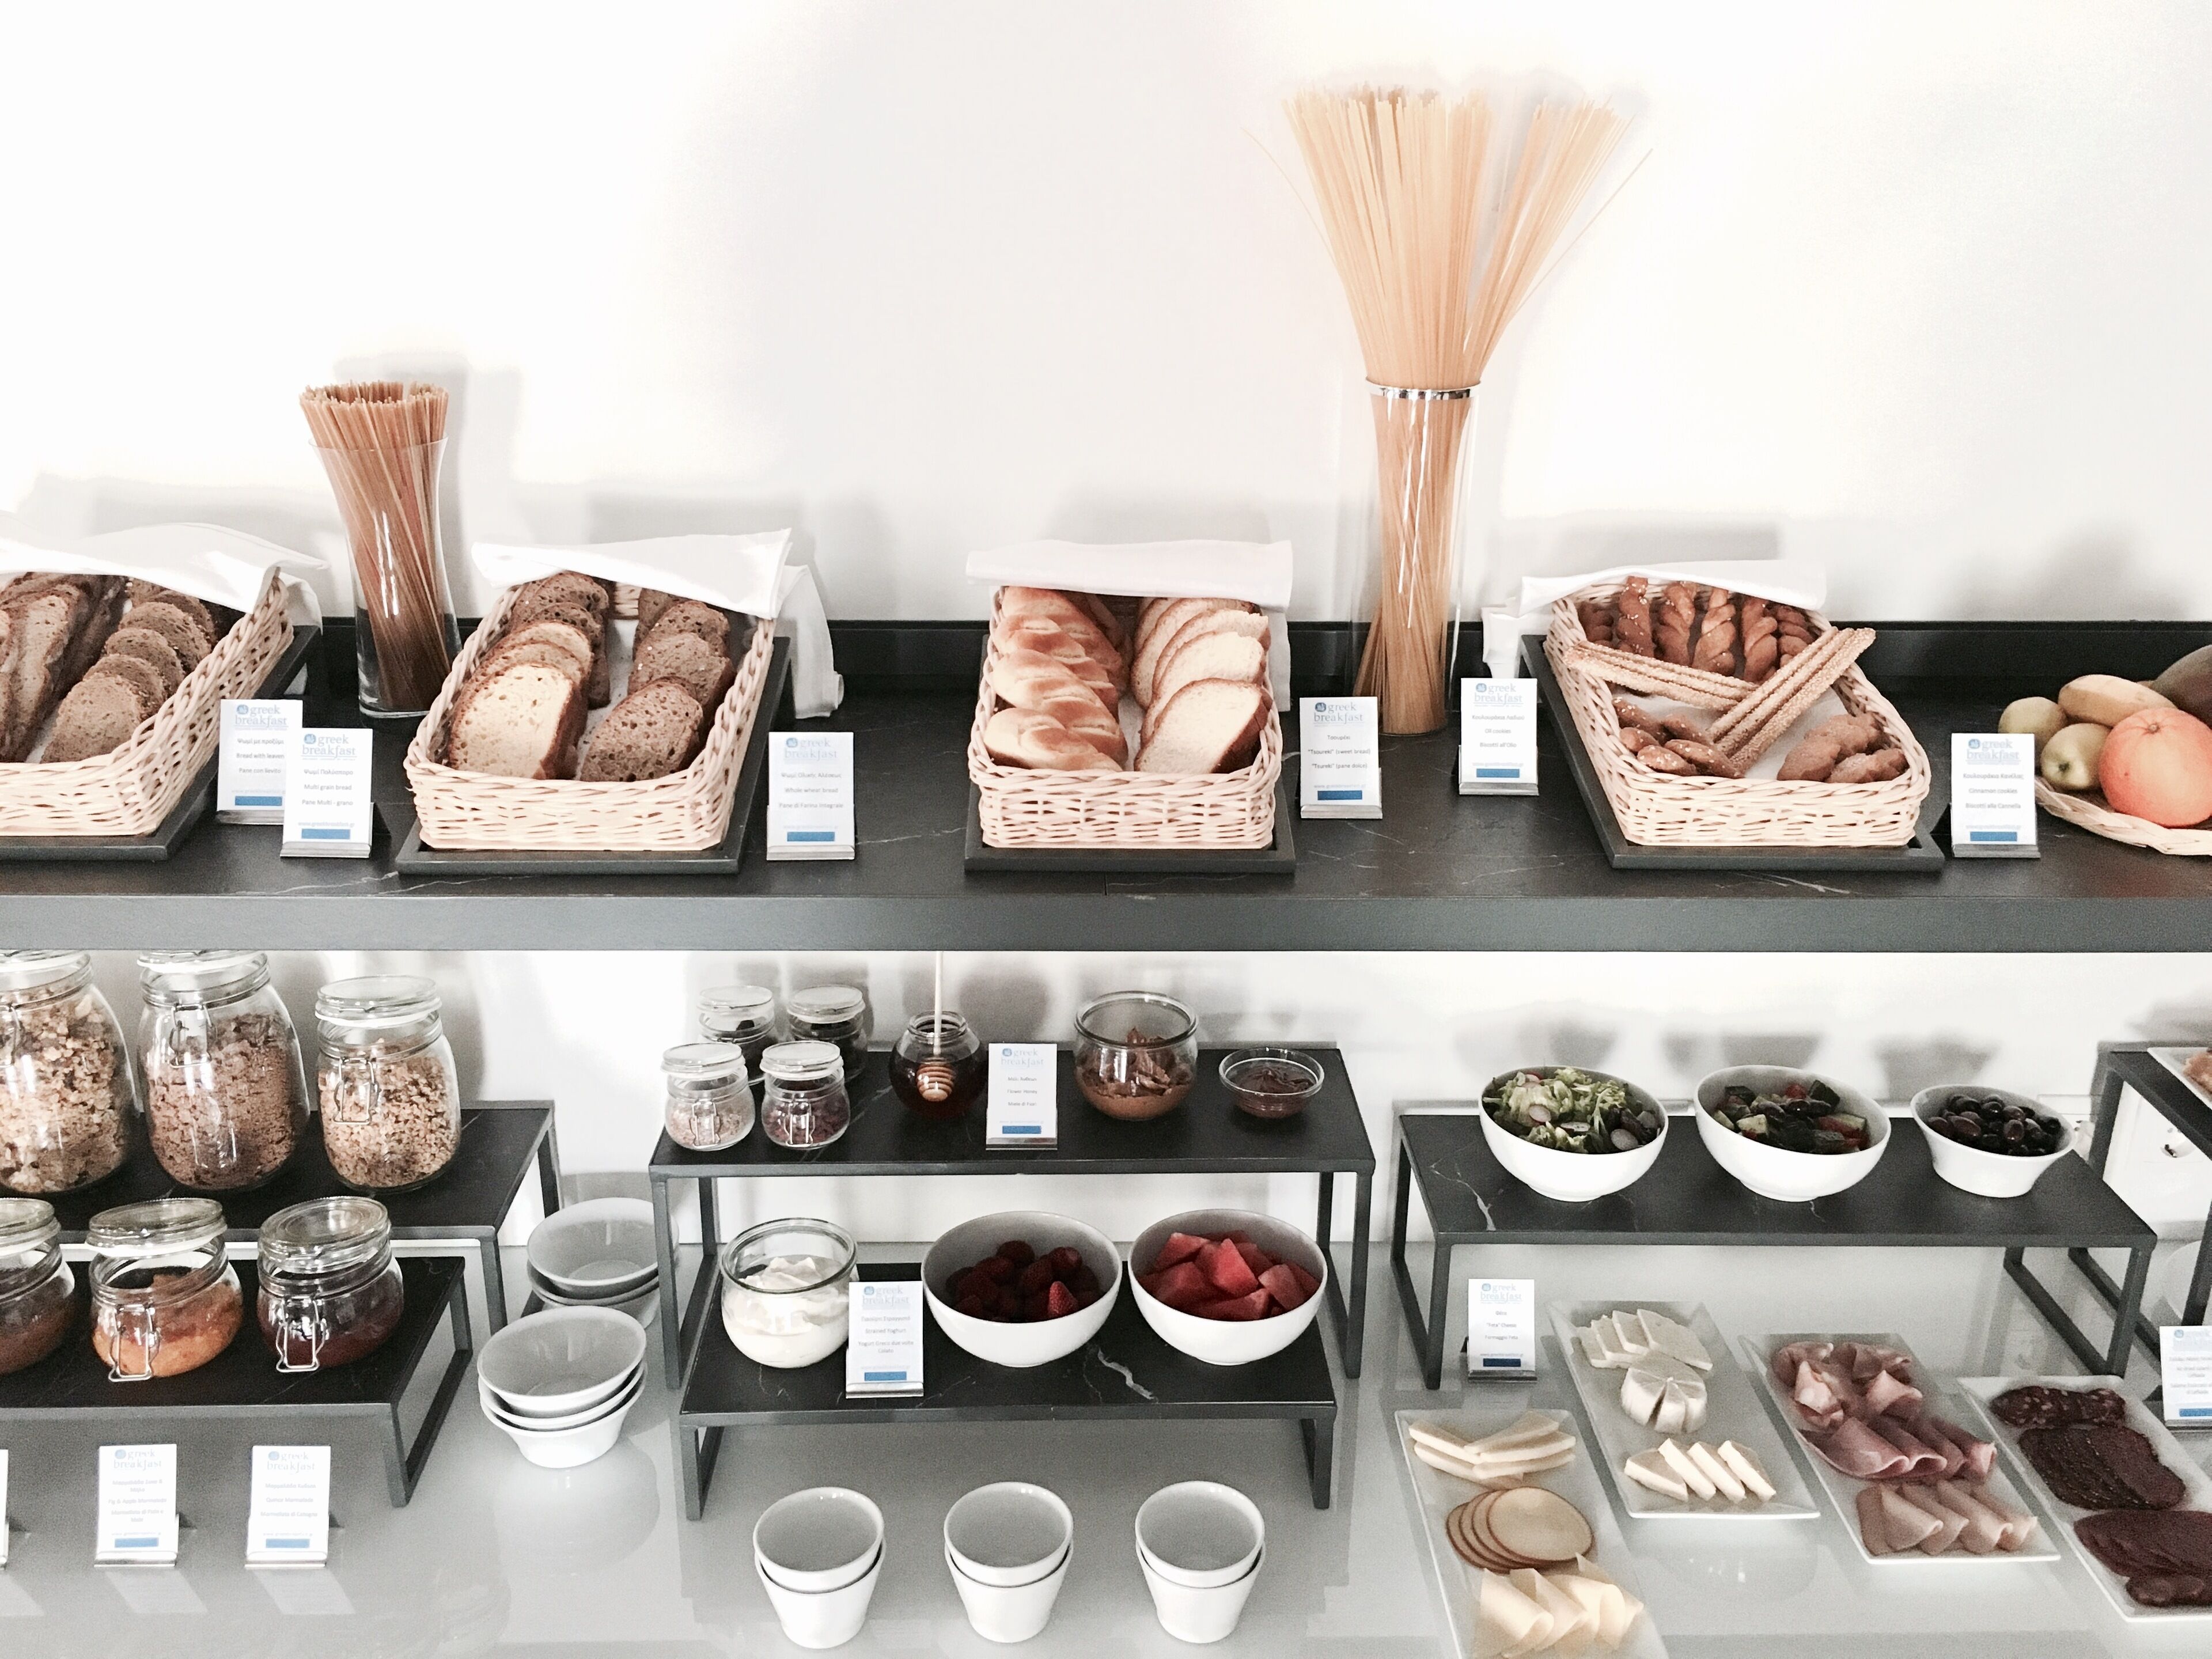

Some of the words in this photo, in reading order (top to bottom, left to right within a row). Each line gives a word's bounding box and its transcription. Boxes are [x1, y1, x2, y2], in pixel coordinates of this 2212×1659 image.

[1488, 683, 1517, 694] greek
[1474, 692, 1522, 706] breakfast
[250, 704, 281, 717] greek
[1328, 702, 1357, 714] greek
[235, 715, 287, 728] breakfast
[1313, 713, 1363, 724] breakfast
[317, 734, 349, 747] greek
[800, 737, 831, 748] greek
[1982, 738, 2013, 752] greek
[302, 744, 355, 758] breakfast
[785, 747, 838, 762] breakfast
[1966, 749, 2020, 763] breakfast
[1013, 1048, 1038, 1059] greek
[1001, 1058, 1044, 1068] breakfast
[875, 1285, 903, 1296] greek
[1493, 1283, 1516, 1293] greek
[862, 1295, 909, 1306] breakfast
[1480, 1291, 1522, 1303] breakfast
[128, 1449, 155, 1460] greek
[281, 1451, 309, 1462] greek
[113, 1459, 162, 1471] breakfast
[267, 1461, 315, 1474] breakfast
